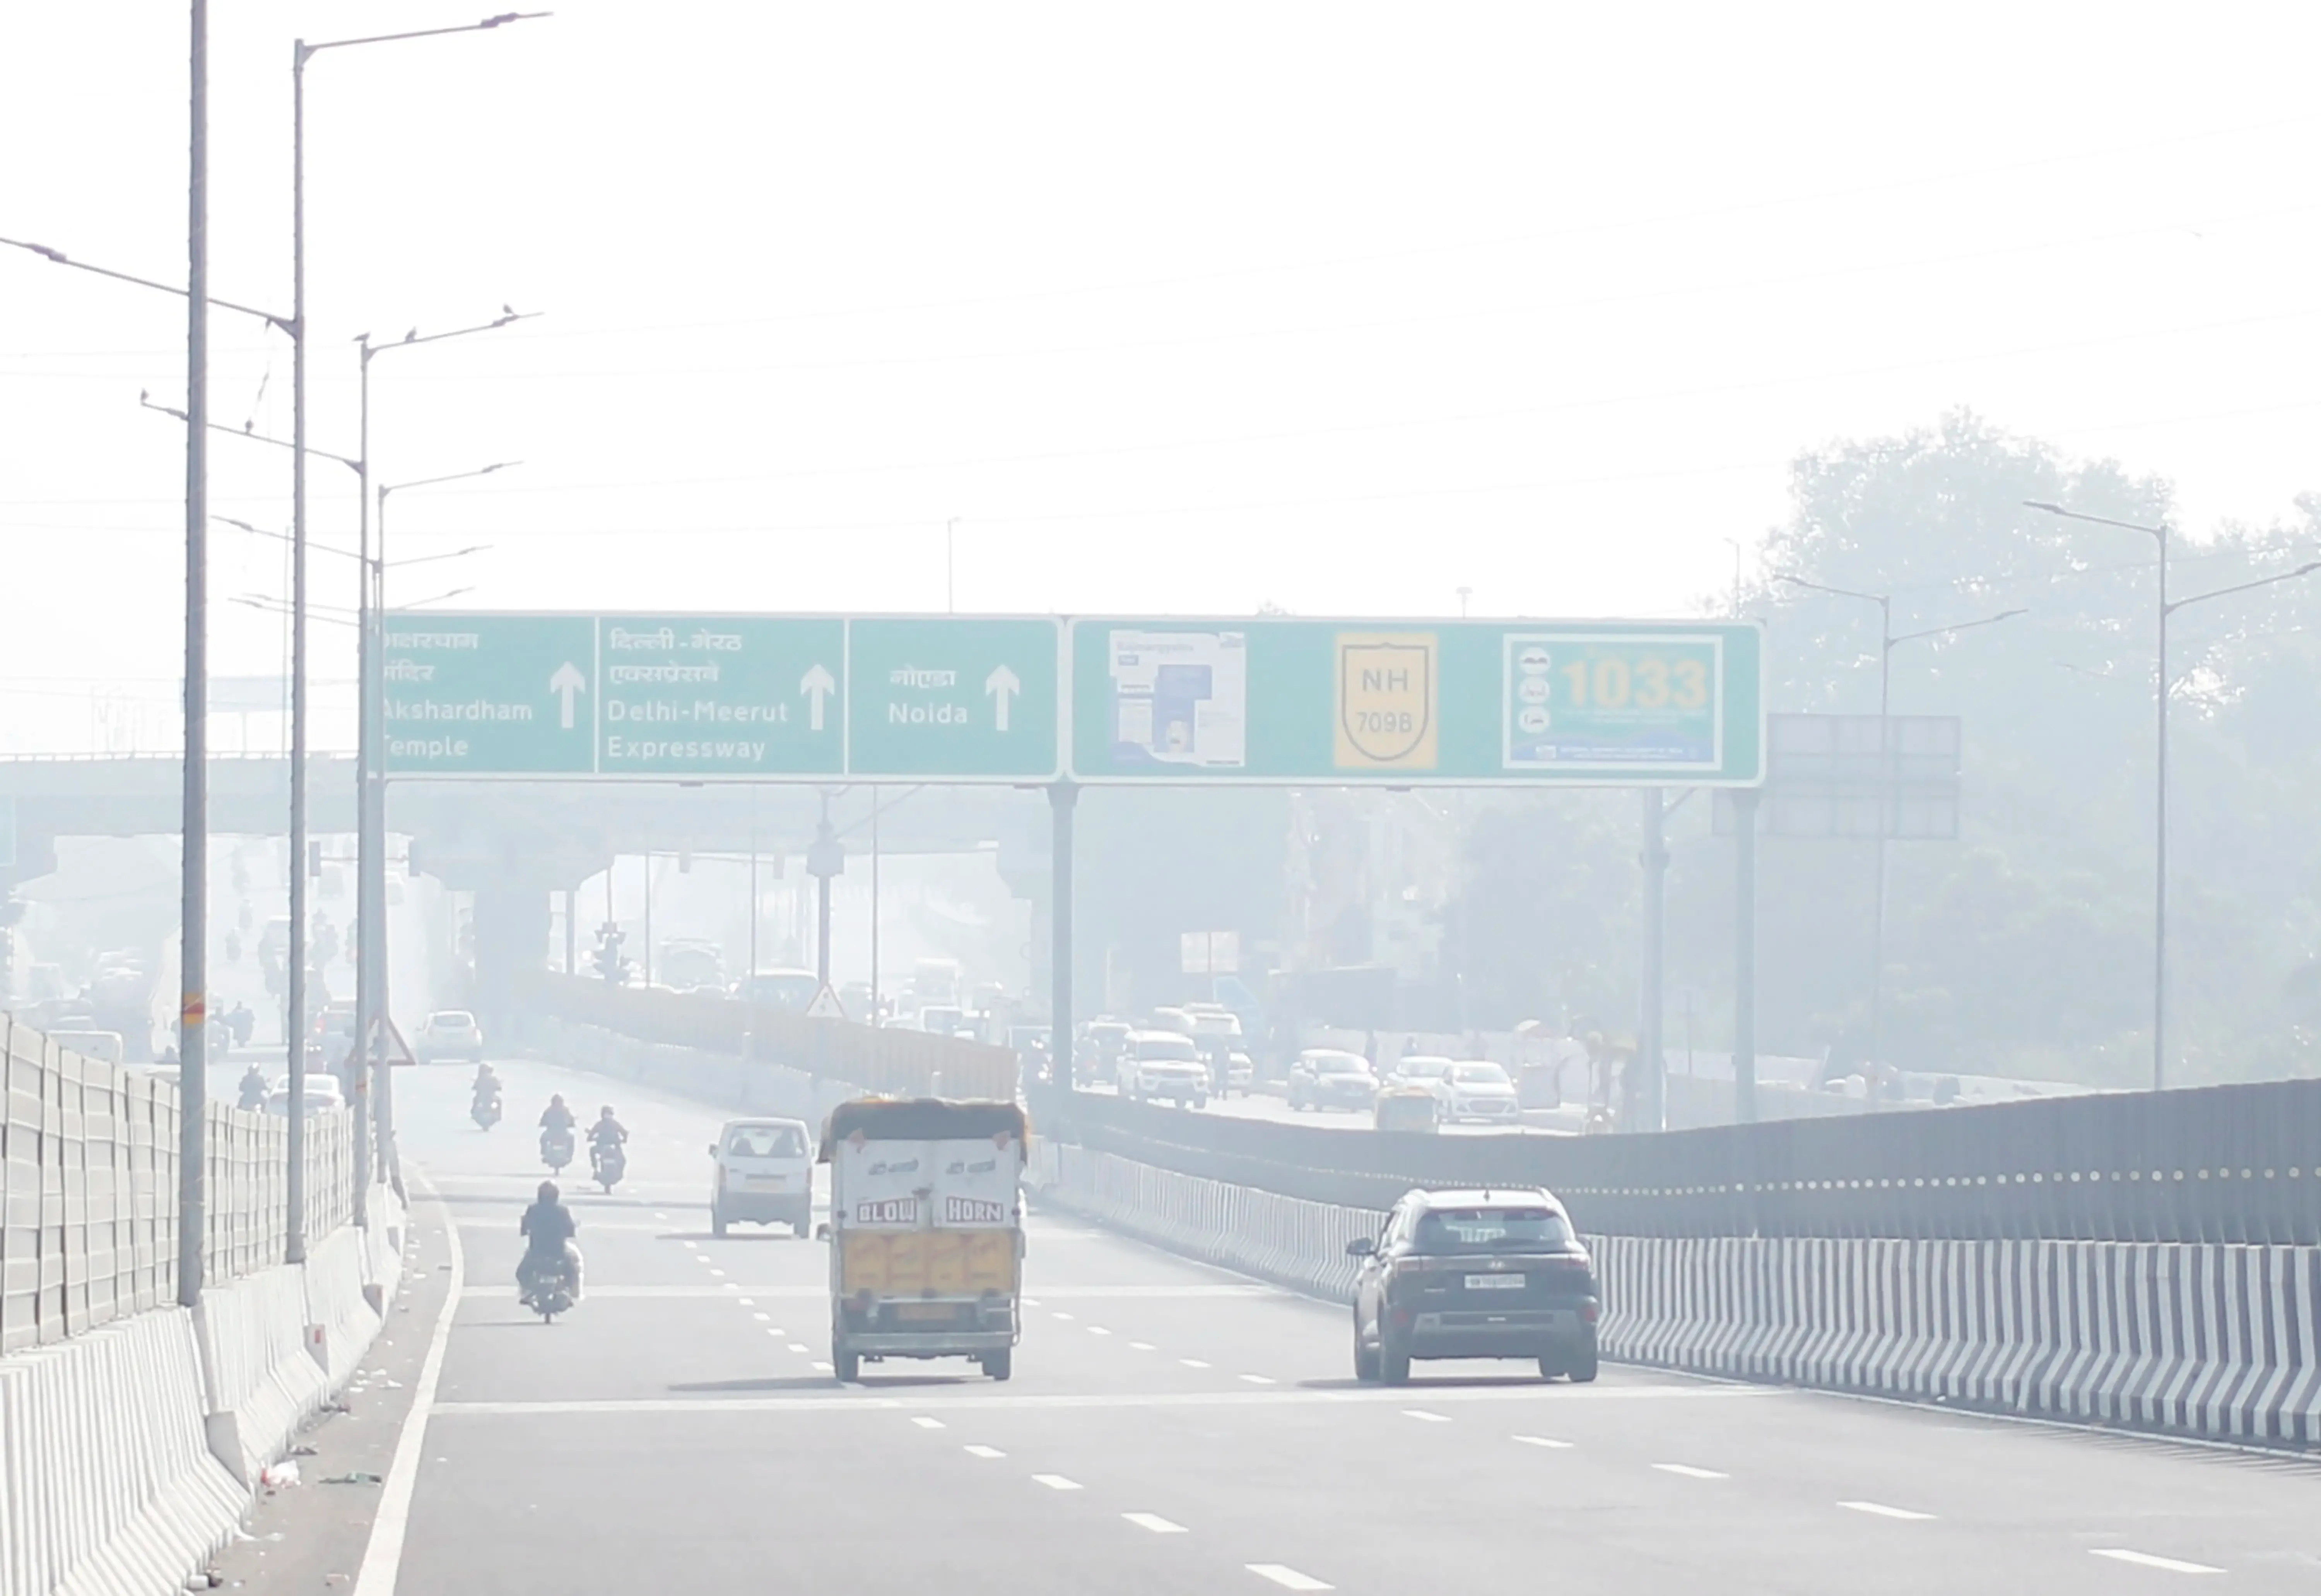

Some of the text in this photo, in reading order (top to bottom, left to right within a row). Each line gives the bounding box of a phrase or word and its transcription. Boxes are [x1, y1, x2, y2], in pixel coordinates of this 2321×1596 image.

[1362, 668, 1408, 692] NH
[1560, 658, 1707, 709] 1033
[608, 699, 788, 722] Delhi-Meerut
[889, 702, 968, 724] Noida
[1356, 711, 1412, 733] 709B
[608, 736, 765, 761] Expressway
[859, 1198, 1002, 1222] BLOW HORN
